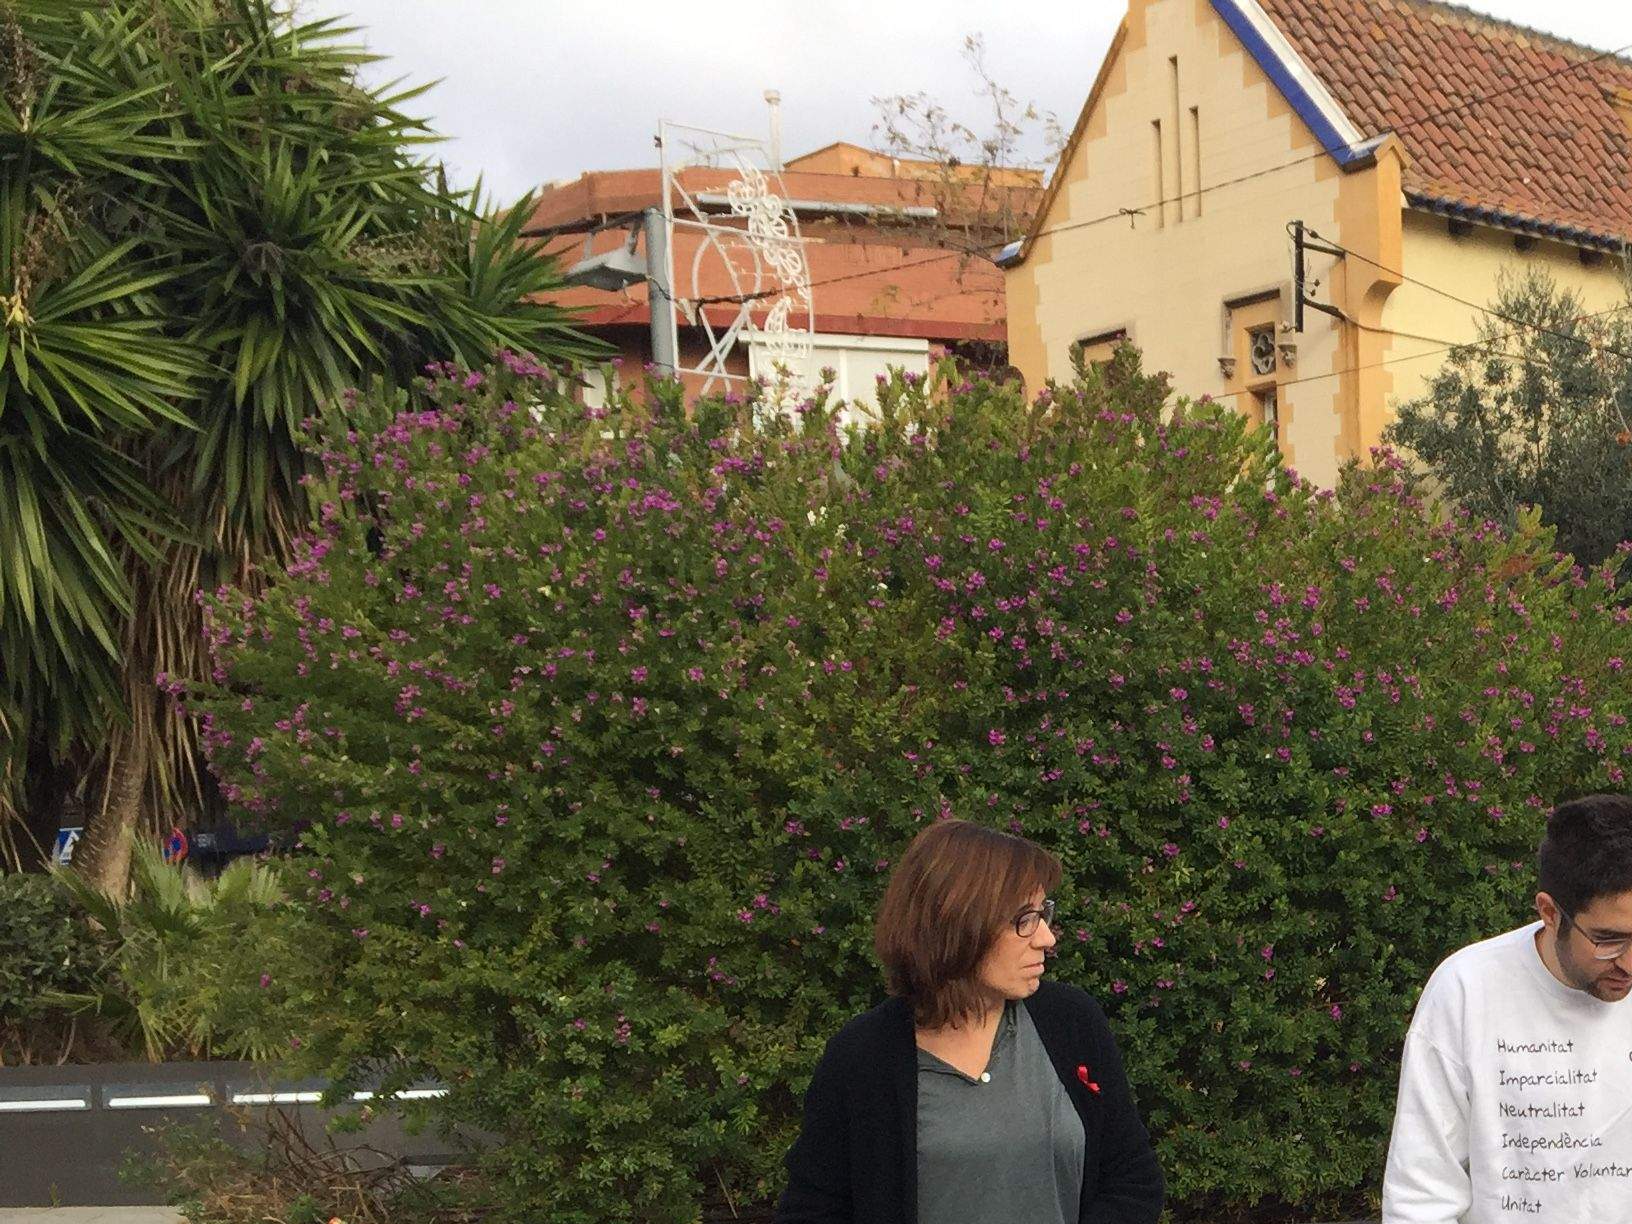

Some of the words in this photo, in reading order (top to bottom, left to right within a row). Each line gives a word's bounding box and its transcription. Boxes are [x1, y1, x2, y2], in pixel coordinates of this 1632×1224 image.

[1497, 1038, 1573, 1053] Humanitat
[1499, 1068, 1598, 1091] Imparcialitat
[1499, 1101, 1585, 1118] Neutralitat
[1501, 1132, 1603, 1154] Independència
[1502, 1165, 1566, 1182] Caràcter
[1501, 1195, 1543, 1213] Unitat
